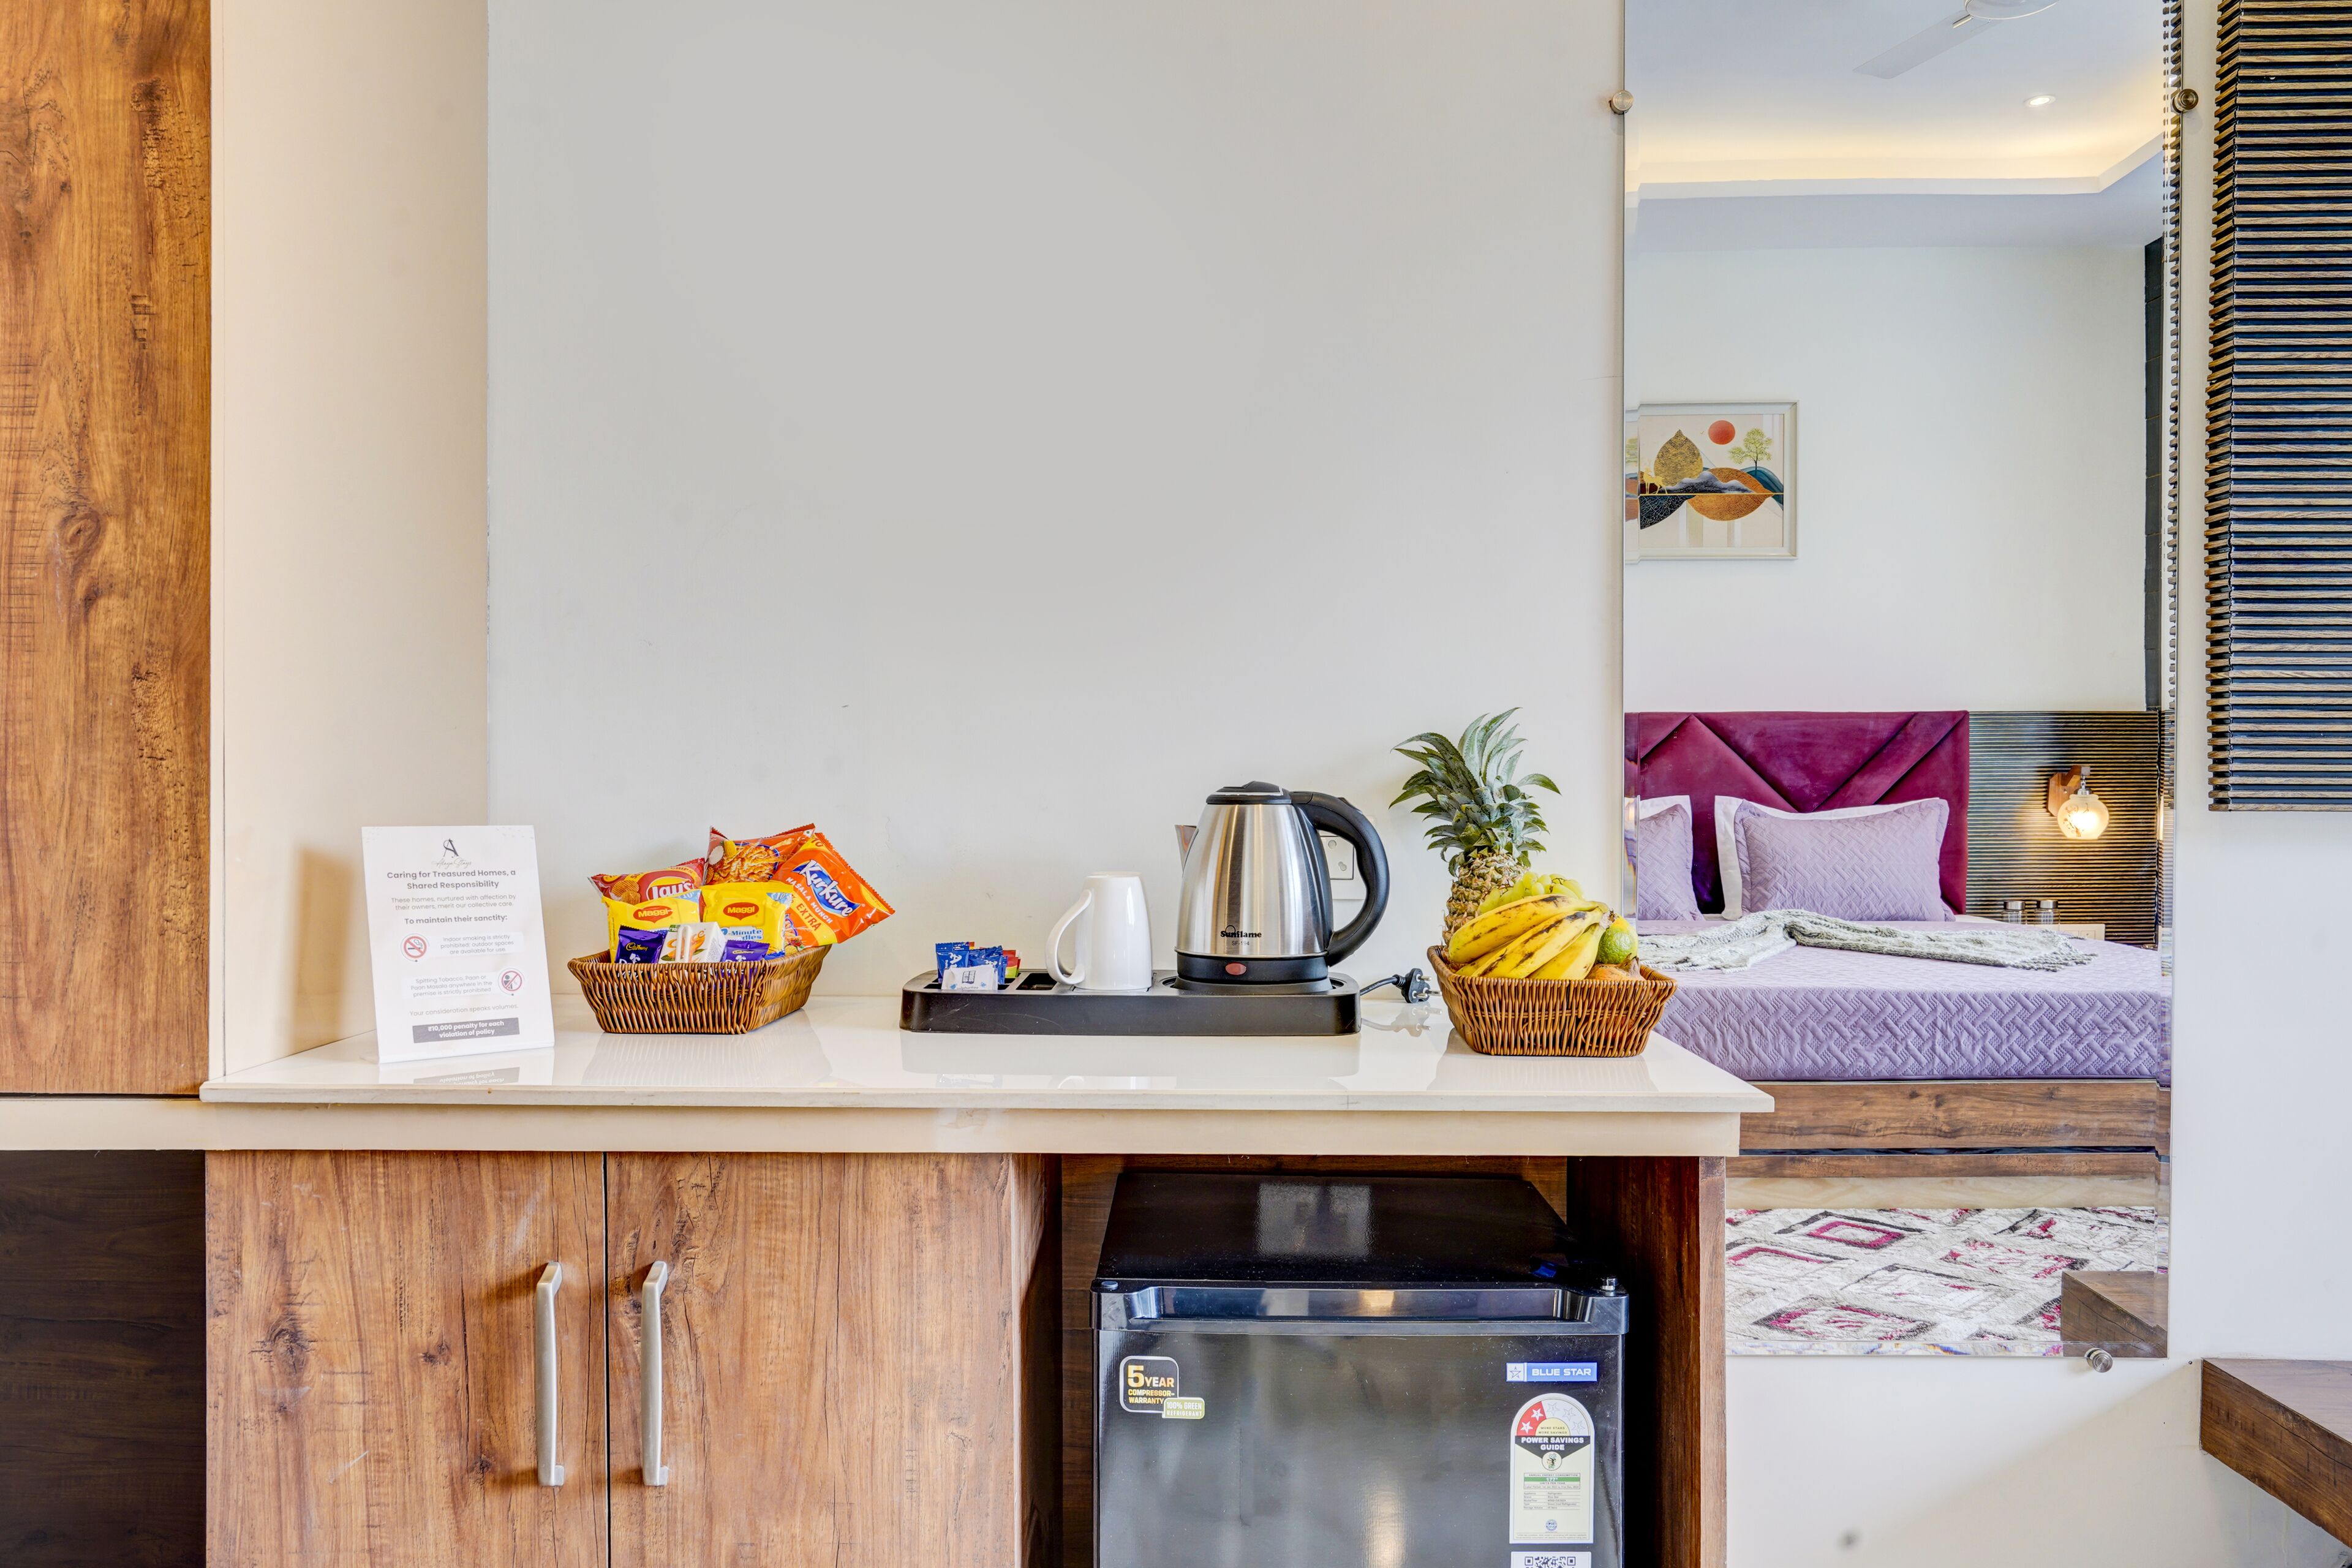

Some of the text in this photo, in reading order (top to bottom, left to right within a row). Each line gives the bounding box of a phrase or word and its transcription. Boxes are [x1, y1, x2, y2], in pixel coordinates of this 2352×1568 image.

[387, 871, 417, 880] Caring
[440, 880, 499, 889] Responsibility
[799, 859, 853, 918] Kurkure
[638, 908, 669, 918] Maggi
[796, 903, 822, 932] EXTRA
[1145, 1376, 1174, 1387] YEAR
